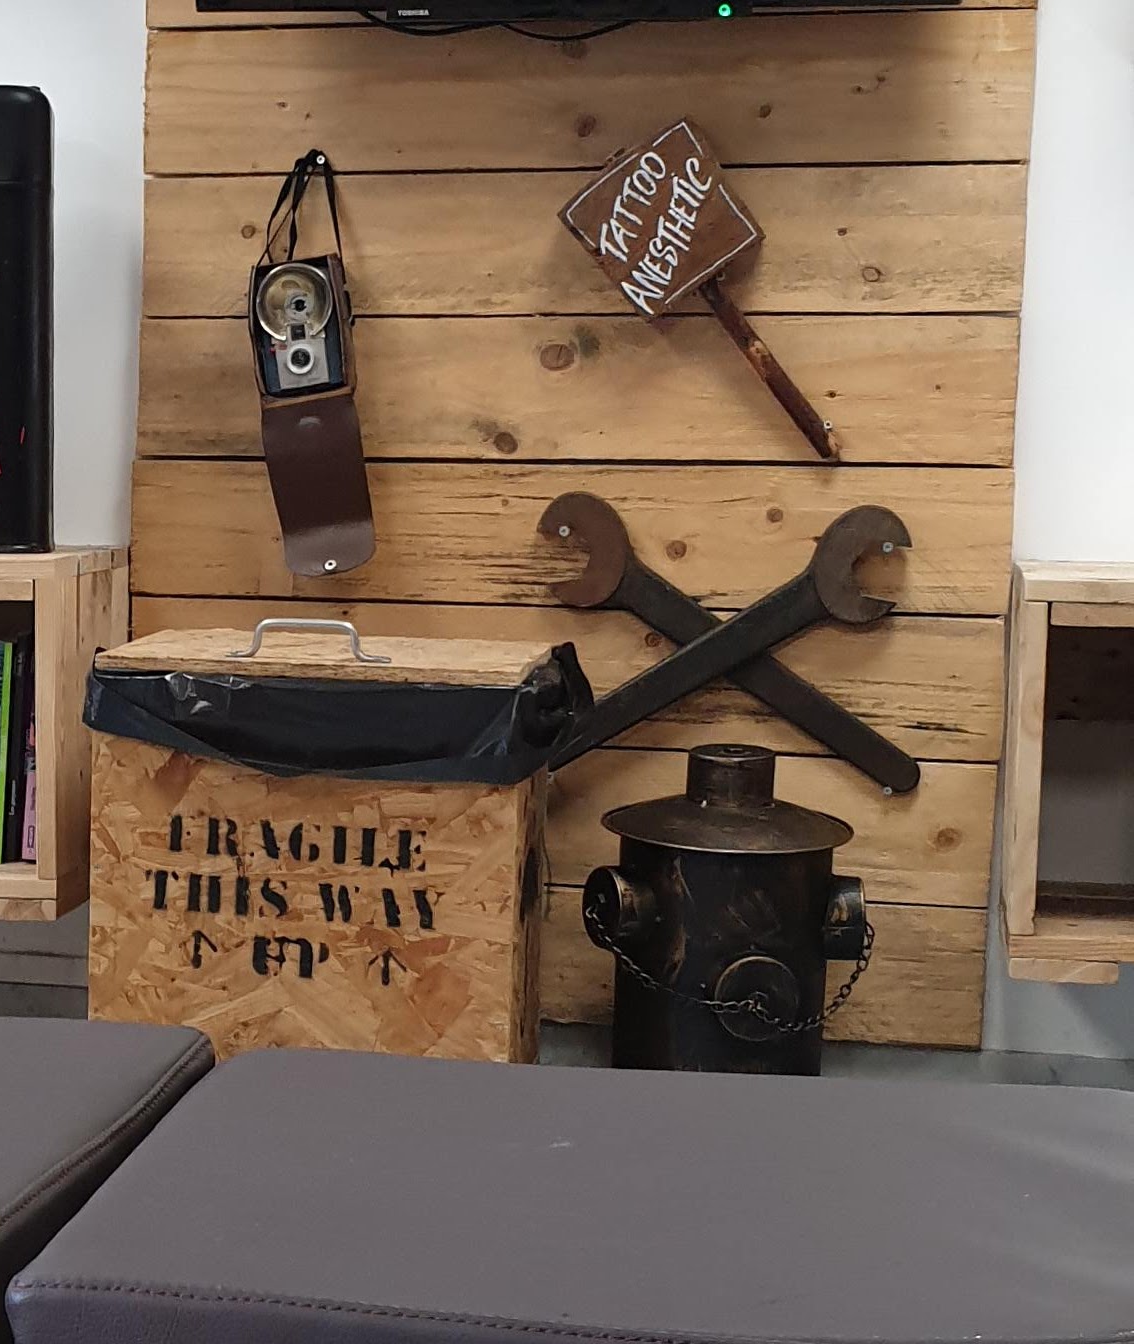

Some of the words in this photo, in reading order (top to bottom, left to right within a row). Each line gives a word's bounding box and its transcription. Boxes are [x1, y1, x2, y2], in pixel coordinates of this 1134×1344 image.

[598, 151, 667, 263] TATTOO
[620, 157, 712, 315] ANESTHETIC
[169, 815, 427, 873] FRAGILE
[145, 868, 288, 917] THIS
